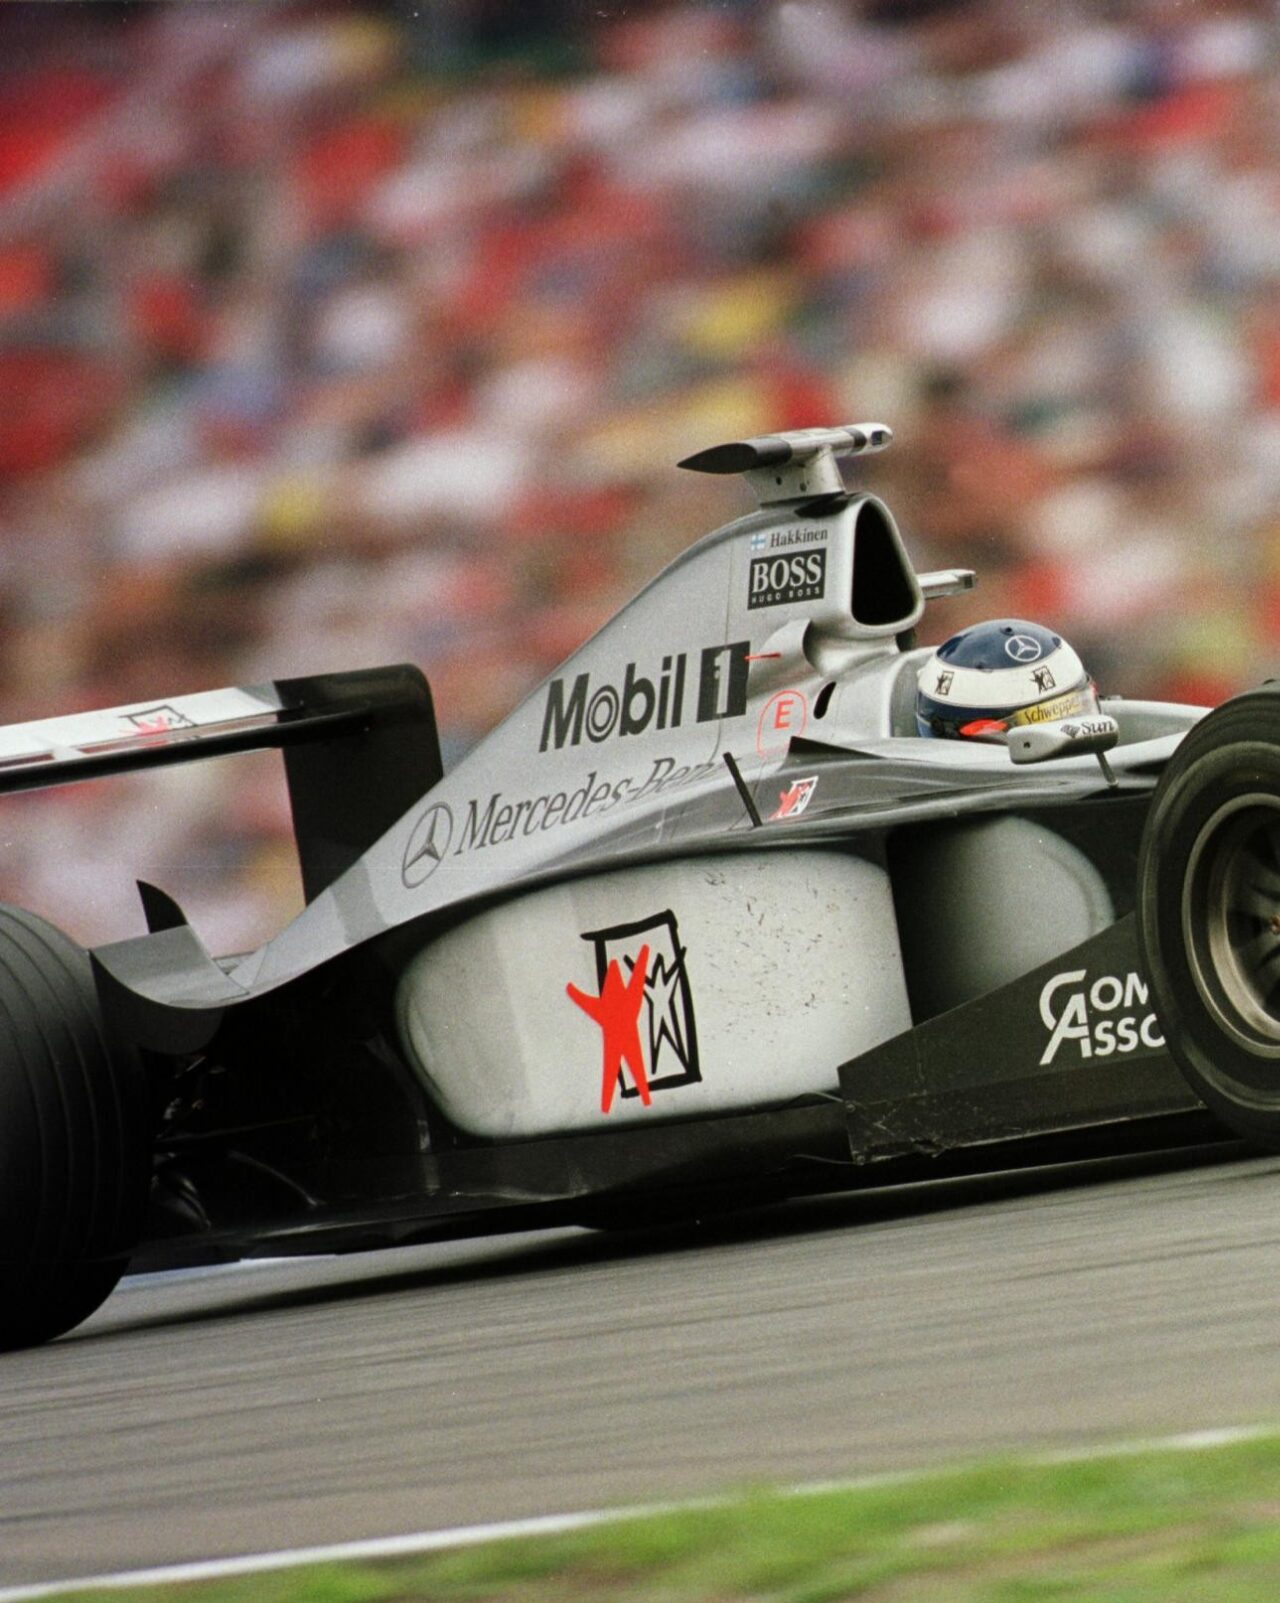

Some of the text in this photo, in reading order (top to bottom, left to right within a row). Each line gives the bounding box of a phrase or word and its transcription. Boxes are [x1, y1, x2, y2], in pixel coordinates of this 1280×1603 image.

[770, 528, 828, 548] Hakkinen
[752, 554, 822, 593] BOSS
[751, 586, 821, 604] HUGO BOSS
[538, 653, 687, 753] Mobil
[773, 699, 794, 730] E
[1080, 720, 1114, 735] Sun
